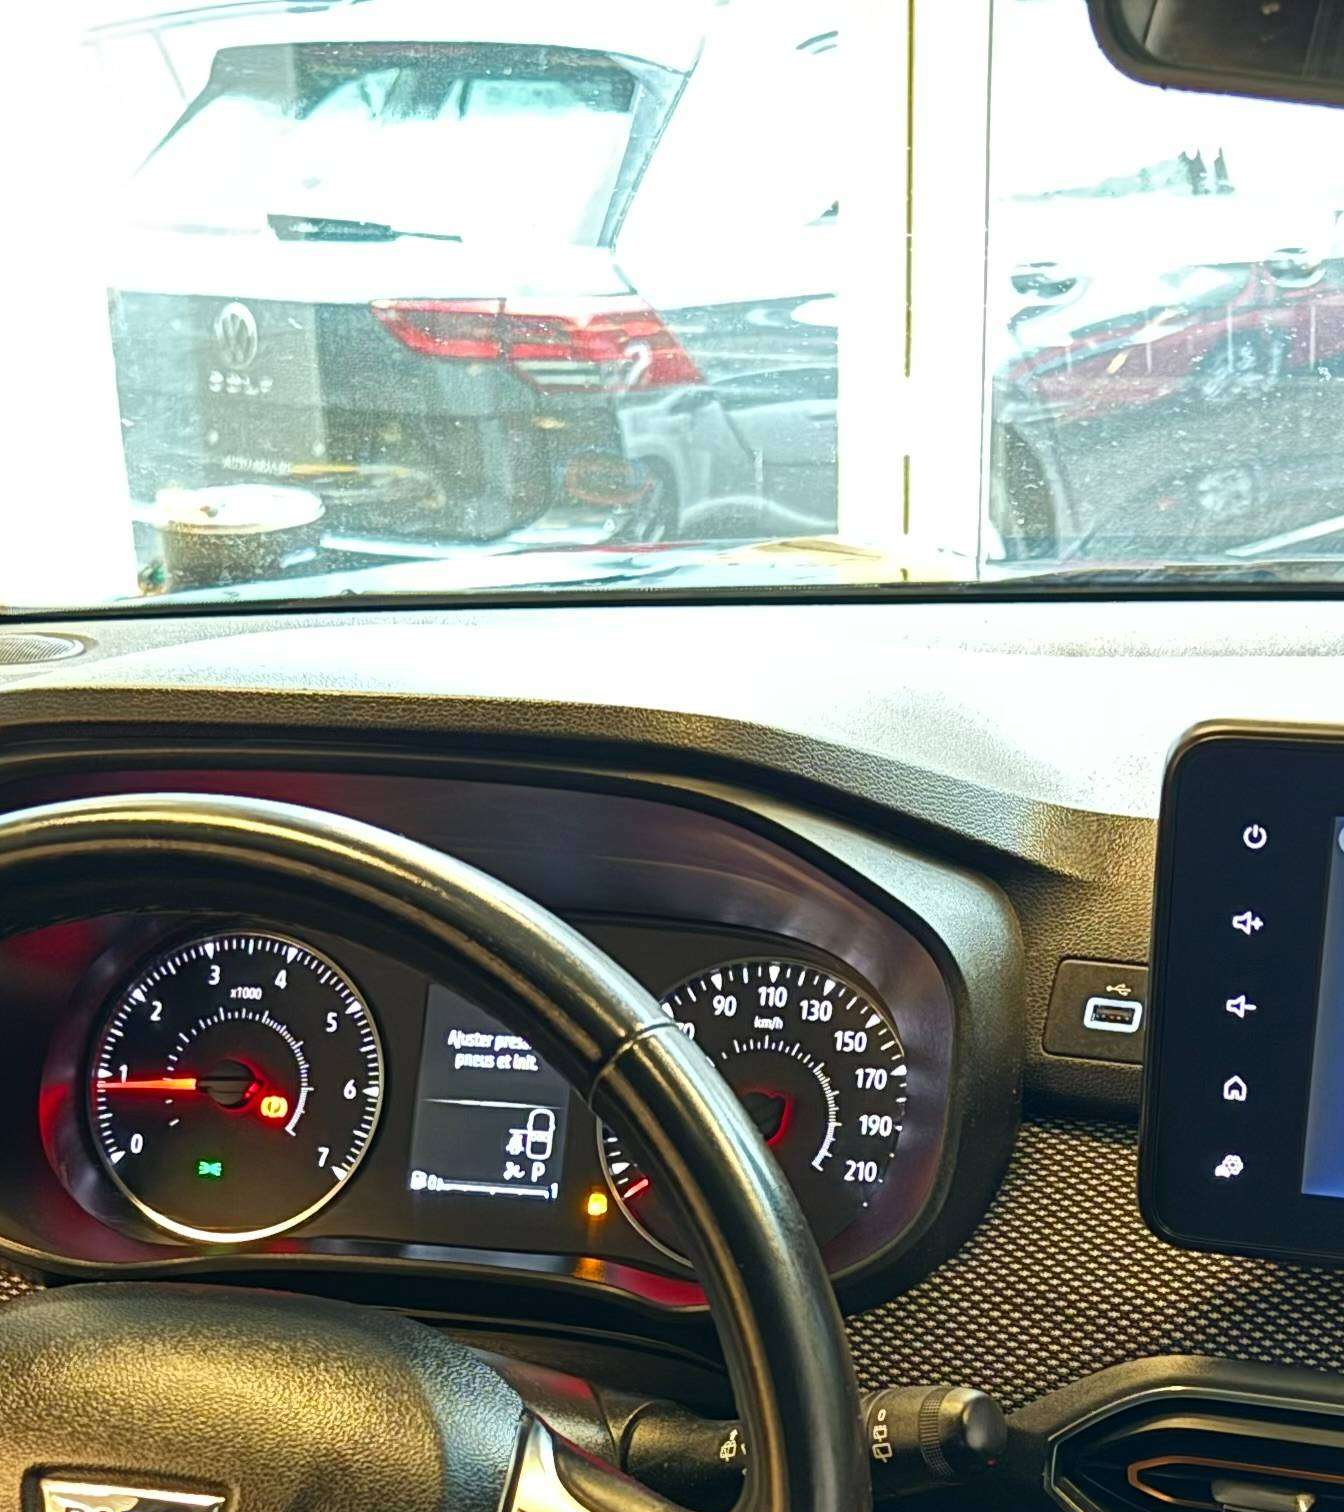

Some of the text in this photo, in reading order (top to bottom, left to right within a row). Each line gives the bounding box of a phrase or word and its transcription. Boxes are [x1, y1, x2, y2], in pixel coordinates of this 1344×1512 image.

[208, 966, 221, 985] 3
[273, 970, 288, 989] 4
[230, 987, 262, 1000] x1000
[758, 986, 788, 1008] 110
[150, 1001, 163, 1021] 2
[712, 995, 737, 1016] 90
[800, 1000, 832, 1022] 130
[326, 1012, 338, 1033] 5
[754, 1016, 783, 1030] km/h
[834, 1031, 867, 1052] 150
[119, 1064, 128, 1083] 1
[855, 1068, 887, 1090] 170
[343, 1080, 356, 1099] 6
[859, 1115, 892, 1136] 190
[130, 1133, 143, 1153] 0
[318, 1147, 330, 1167] 7
[531, 1161, 545, 1182] P
[844, 1160, 877, 1182] 210
